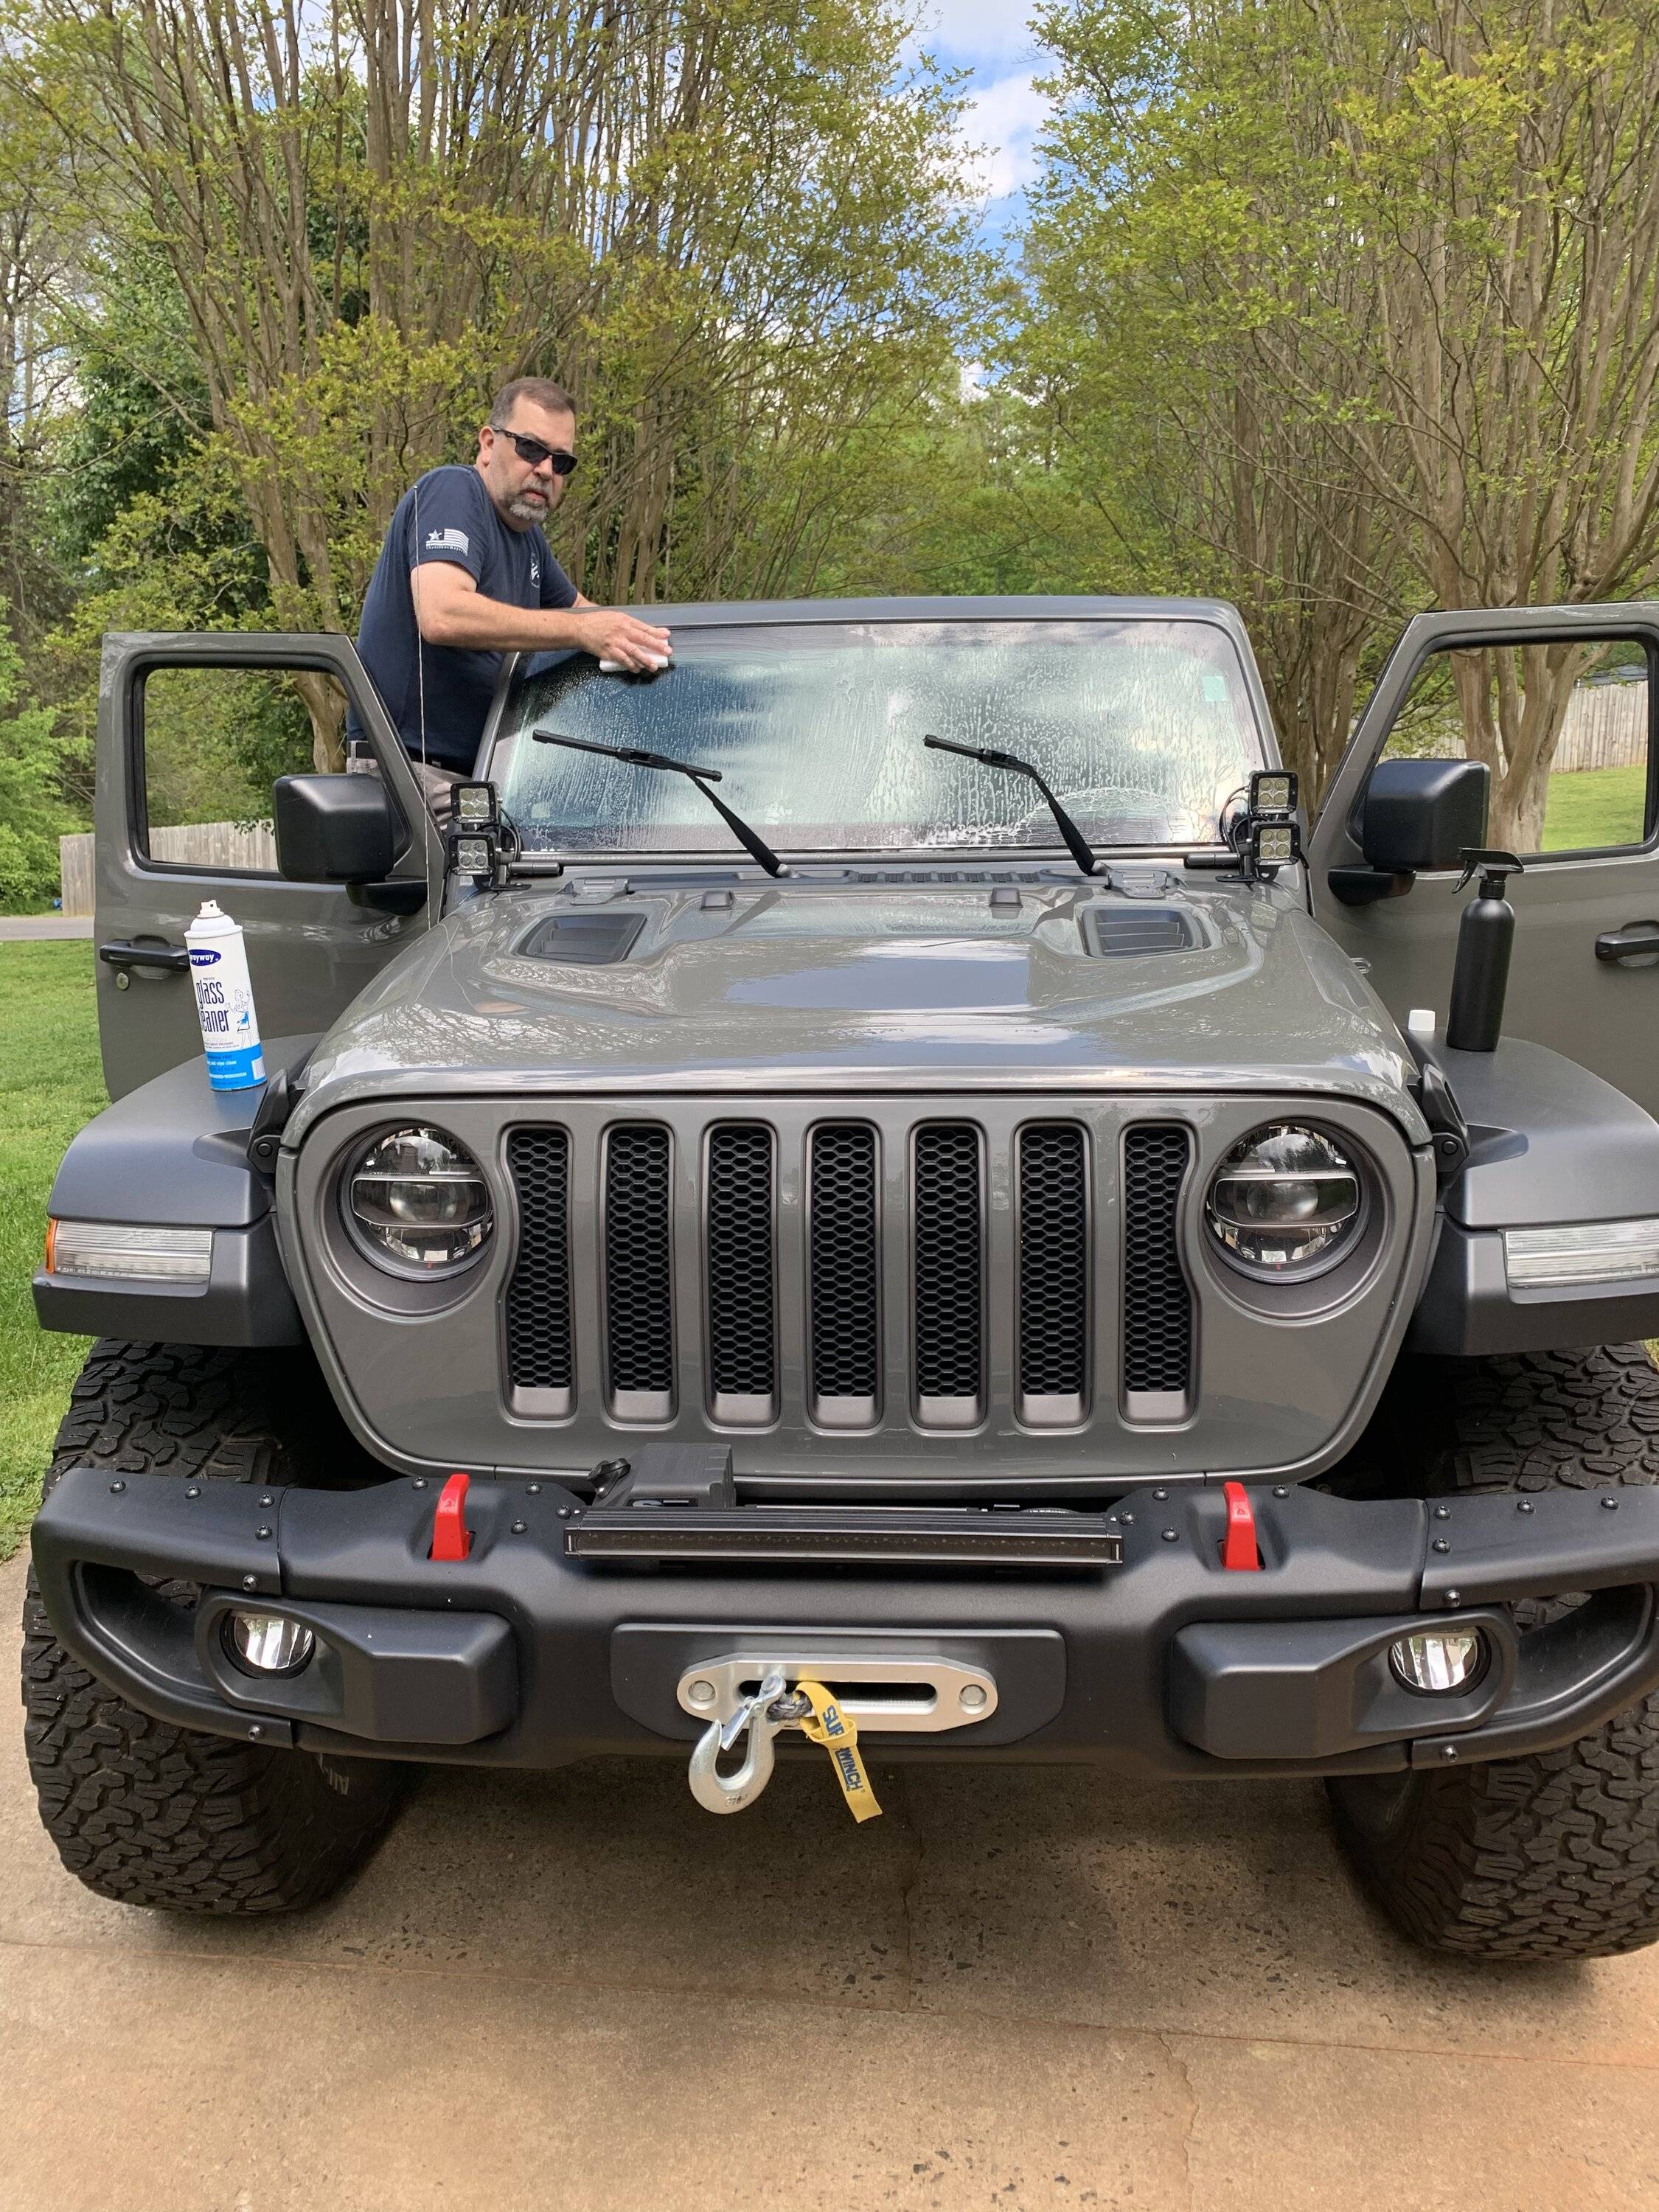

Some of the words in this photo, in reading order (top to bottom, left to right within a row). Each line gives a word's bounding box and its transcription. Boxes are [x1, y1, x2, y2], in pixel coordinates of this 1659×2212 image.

[196, 979, 225, 1009] glass
[199, 1009, 229, 1033] eaner
[838, 1747, 863, 1792] WINCH
